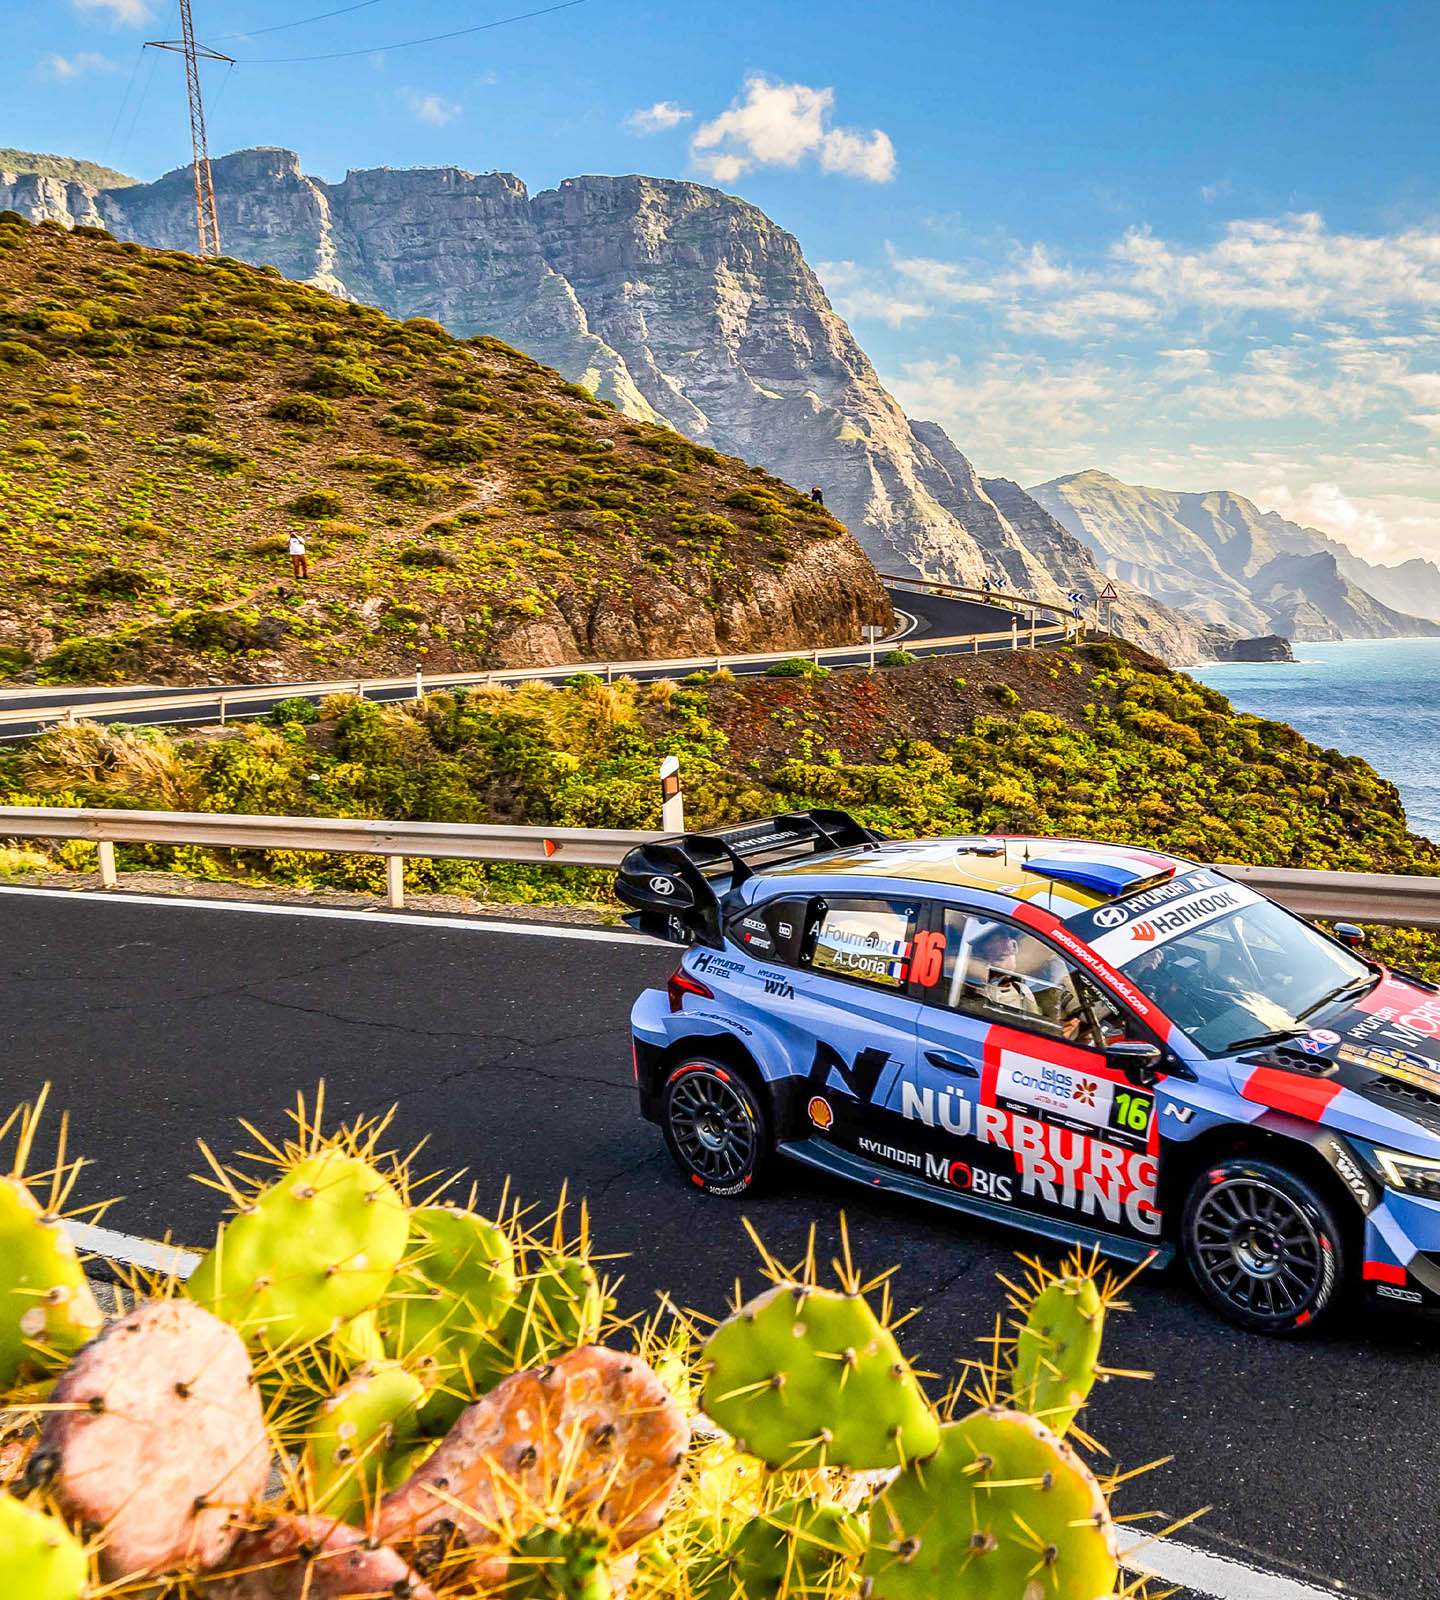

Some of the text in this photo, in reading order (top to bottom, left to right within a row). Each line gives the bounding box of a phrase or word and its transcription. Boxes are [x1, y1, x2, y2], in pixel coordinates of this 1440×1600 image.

[1124, 880, 1190, 914] HYUNDAI
[706, 966, 731, 979] STEEL
[712, 956, 746, 973] HYUNDAI
[908, 929, 947, 988] 16
[1050, 929, 1149, 1016] motorsport.hyundai.com
[1347, 1006, 1400, 1040] HYUNDAI
[1012, 1070, 1072, 1100] Canarias
[1041, 1066, 1073, 1087] Islas
[1115, 1093, 1151, 1131] 16
[901, 1080, 1160, 1188] NÜRBURG
[859, 1137, 1013, 1202] HYUNDAI MOBIS
[1021, 1152, 1162, 1235] RING
[1376, 1284, 1423, 1303] sparco
